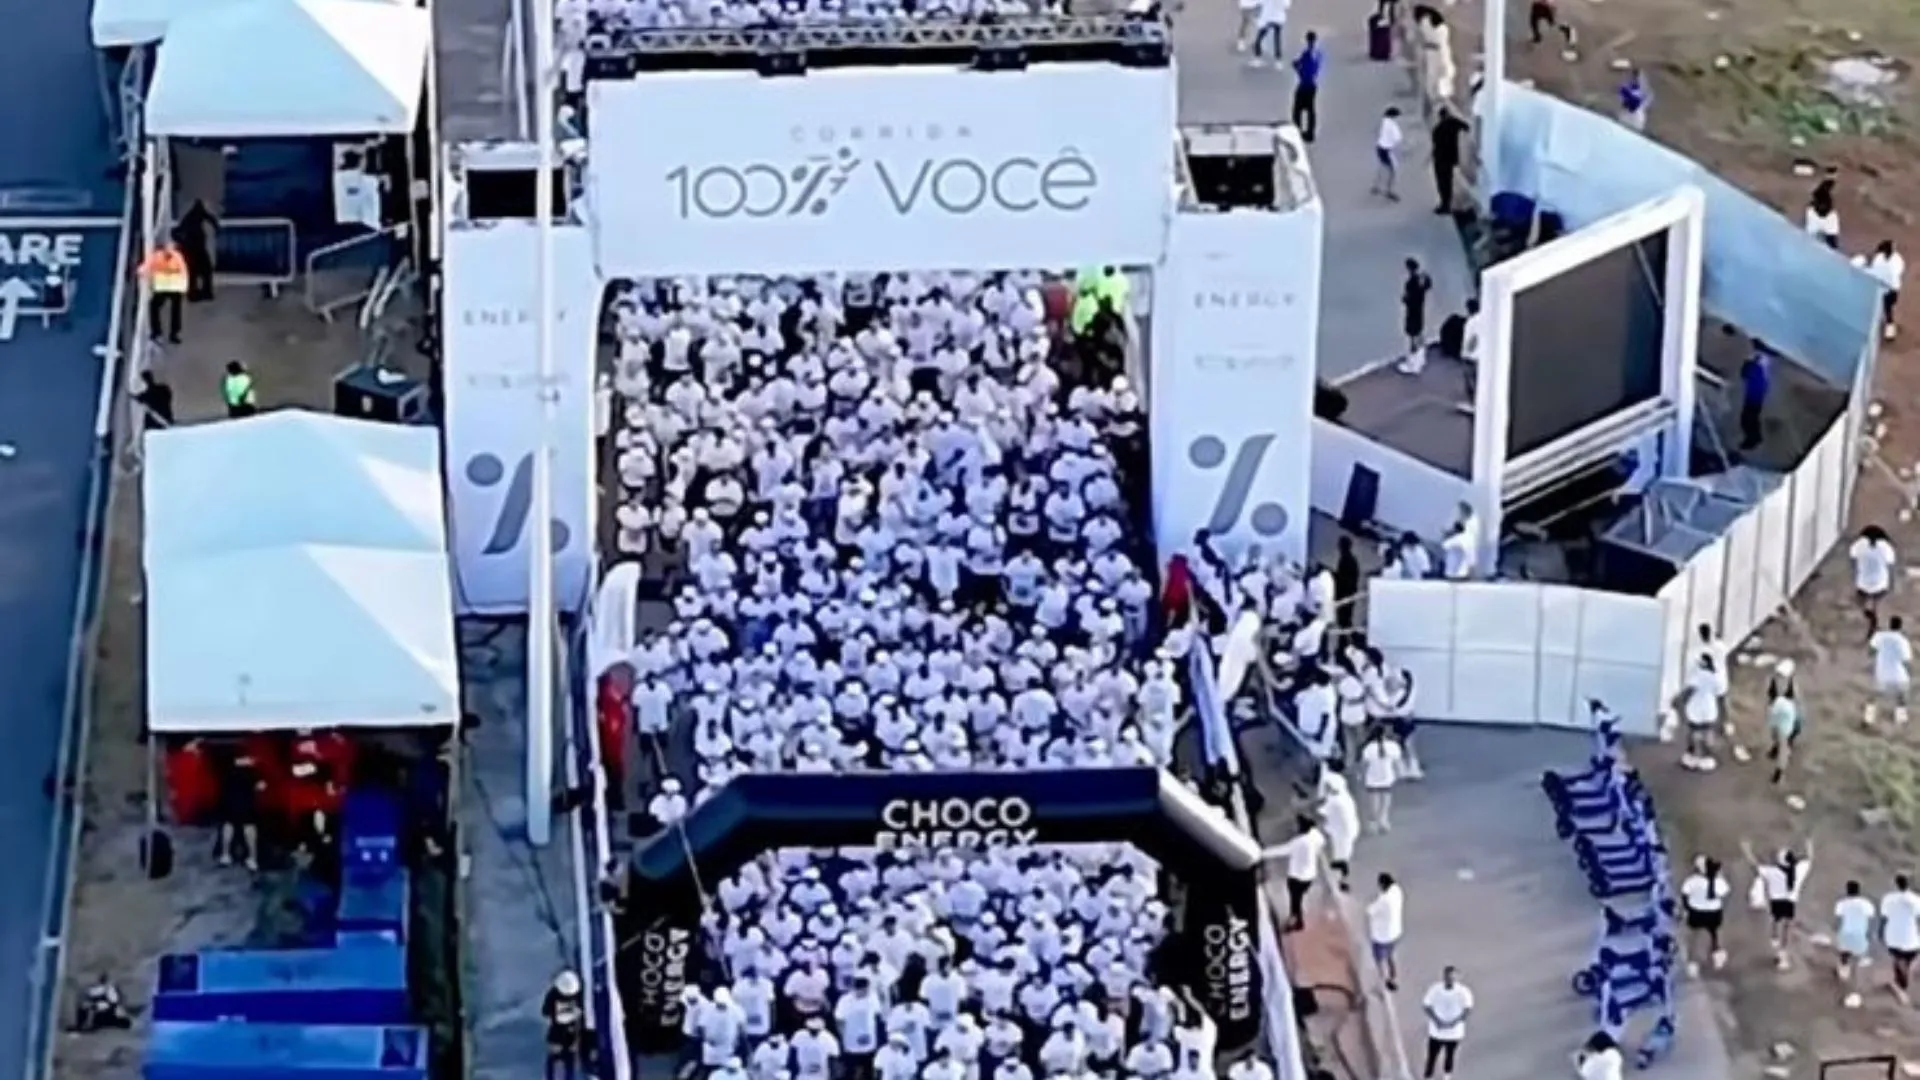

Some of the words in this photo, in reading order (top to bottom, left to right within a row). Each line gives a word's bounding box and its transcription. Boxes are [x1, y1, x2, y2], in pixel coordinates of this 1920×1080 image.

[463, 308, 569, 327] ENERY
[881, 796, 1032, 829] CHOCO
[639, 932, 666, 1017] HOCO
[1227, 917, 1251, 1021] ENERGY
